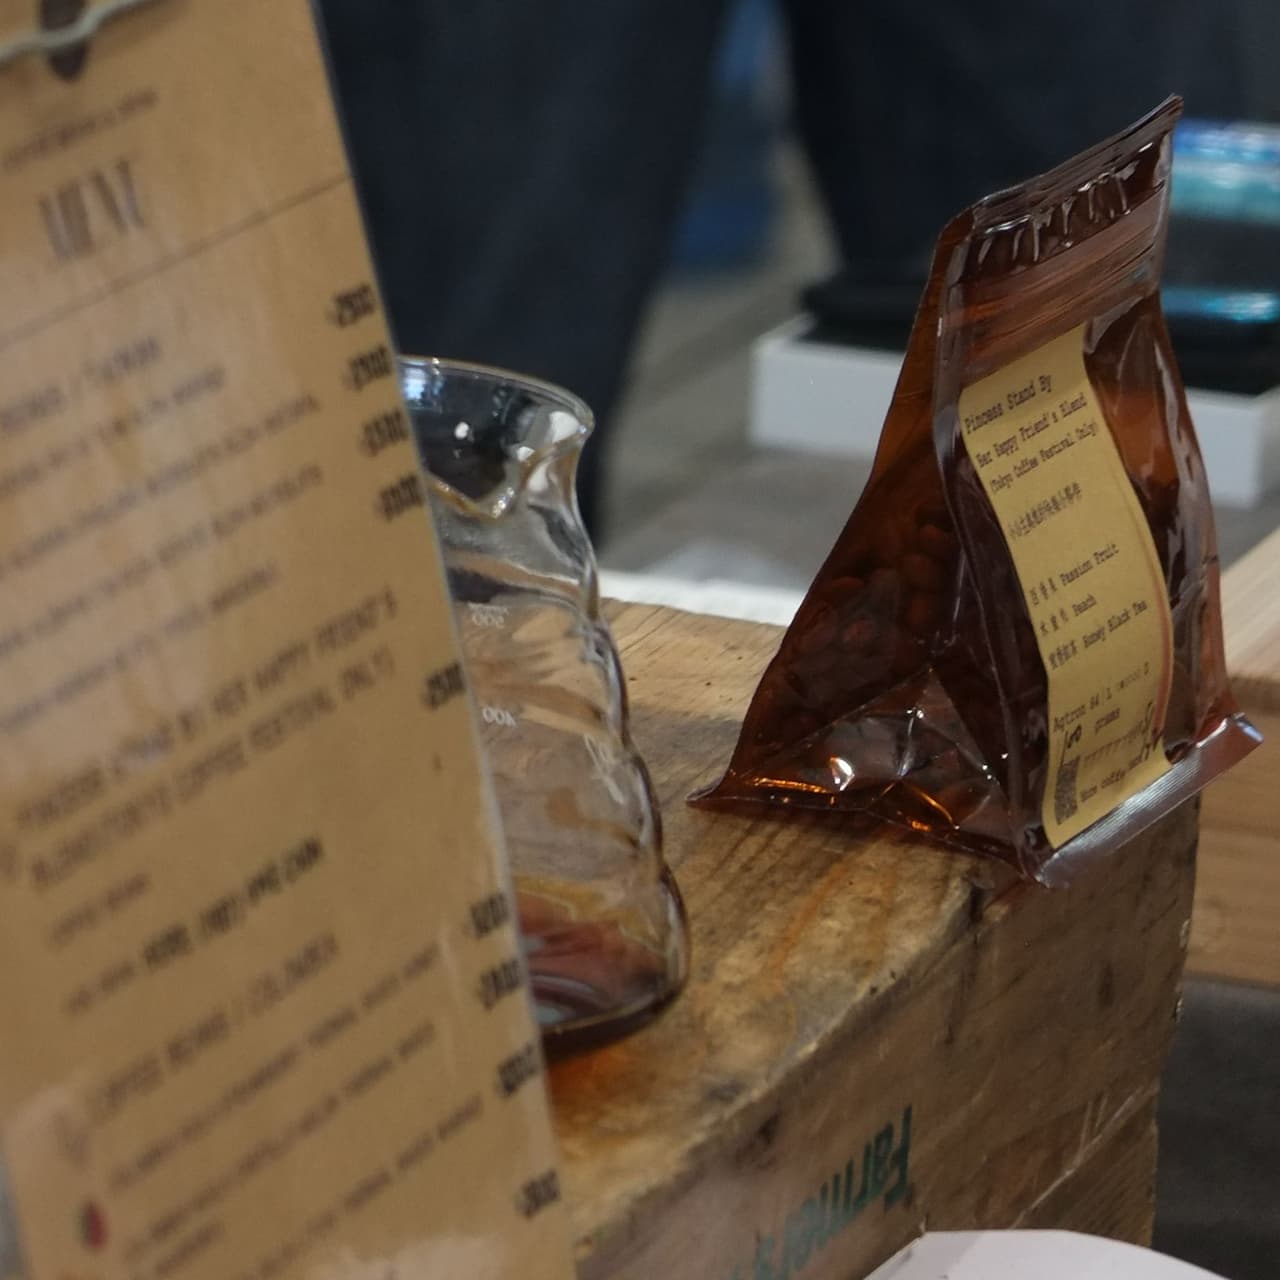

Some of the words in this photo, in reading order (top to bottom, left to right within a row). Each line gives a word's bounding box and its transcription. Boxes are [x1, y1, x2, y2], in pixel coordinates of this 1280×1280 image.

[1007, 379, 1037, 410] Stand
[1038, 375, 1052, 394] By
[976, 451, 993, 468] Her
[993, 435, 1019, 457] Happy
[1019, 411, 1059, 442] Friend's
[1059, 391, 1088, 418] Blend
[1013, 457, 1040, 479] Coffee
[1039, 432, 1076, 463] Festival
[1060, 559, 1094, 587] Passion
[1093, 543, 1119, 565] Fruit
[1071, 593, 1098, 617] Peach
[1083, 626, 1106, 649] Honey
[1107, 608, 1131, 633] Black
[1131, 600, 1148, 617] Tea
